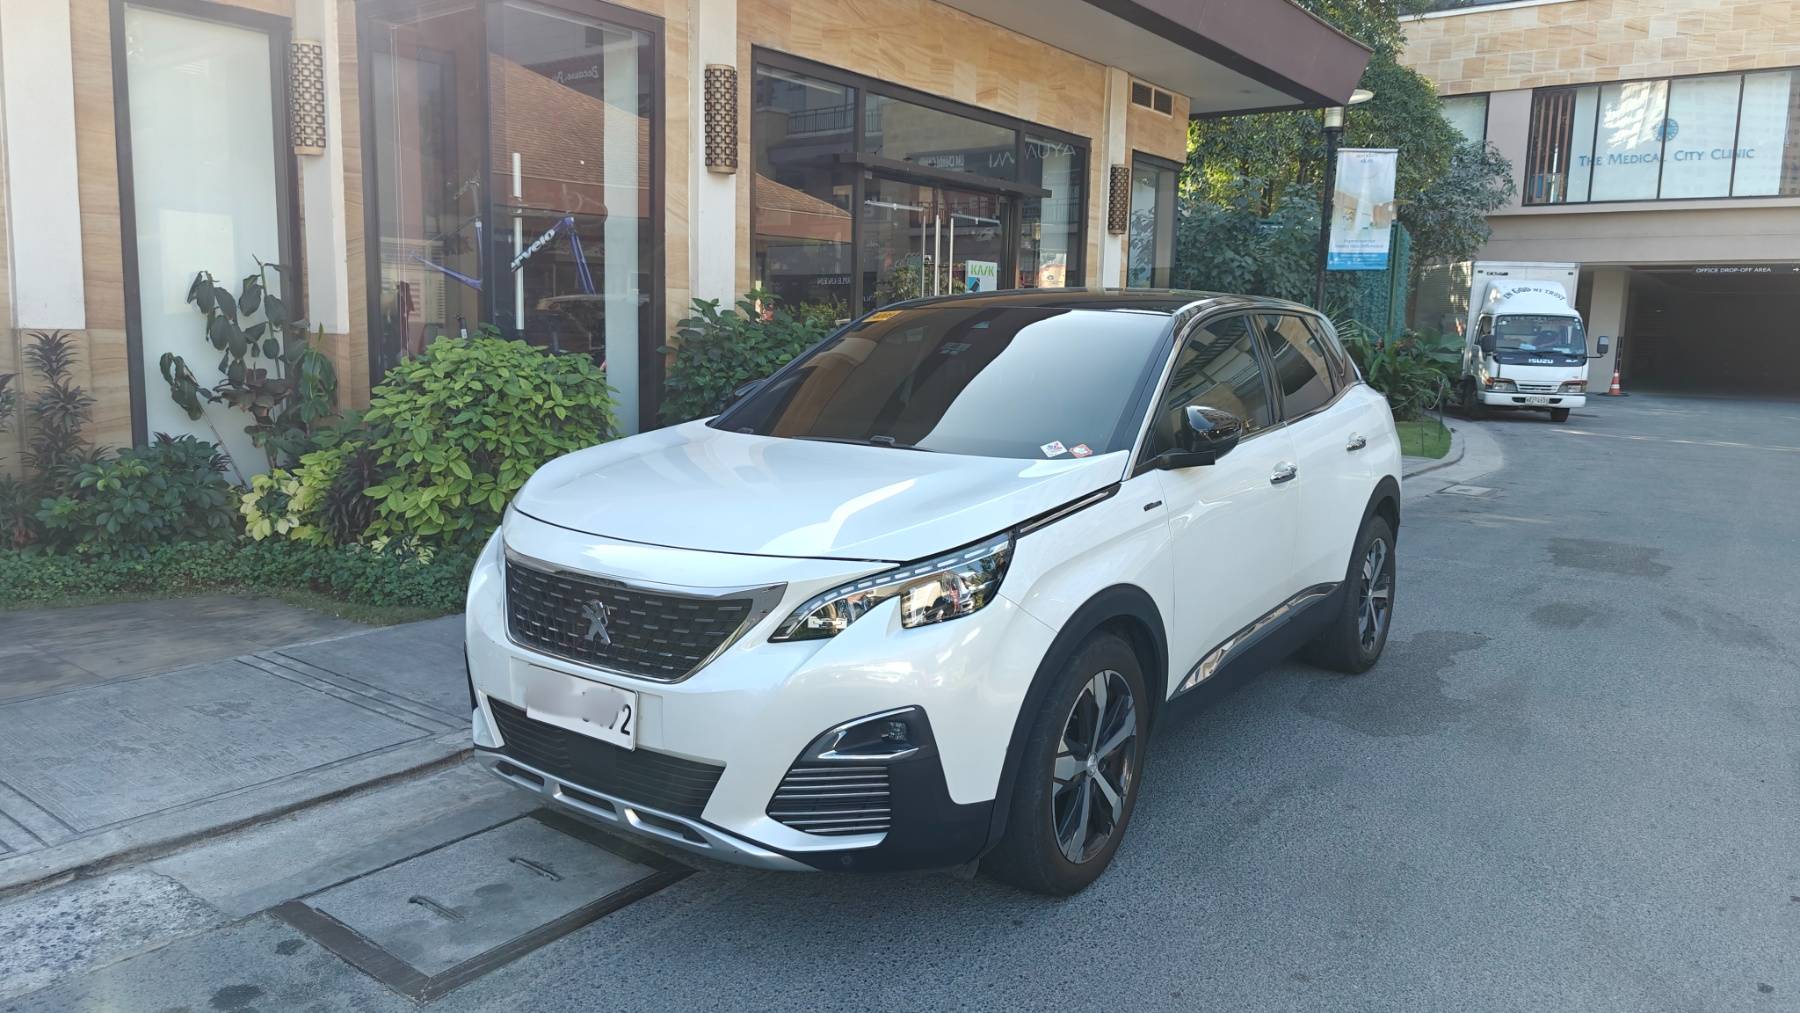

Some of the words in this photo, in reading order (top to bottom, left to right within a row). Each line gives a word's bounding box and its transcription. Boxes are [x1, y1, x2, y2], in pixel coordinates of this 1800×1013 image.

[1578, 155, 1602, 167] THE
[1608, 152, 1667, 165] MEDICA
[1674, 150, 1704, 161] CITY
[1710, 148, 1756, 160] CLINIC
